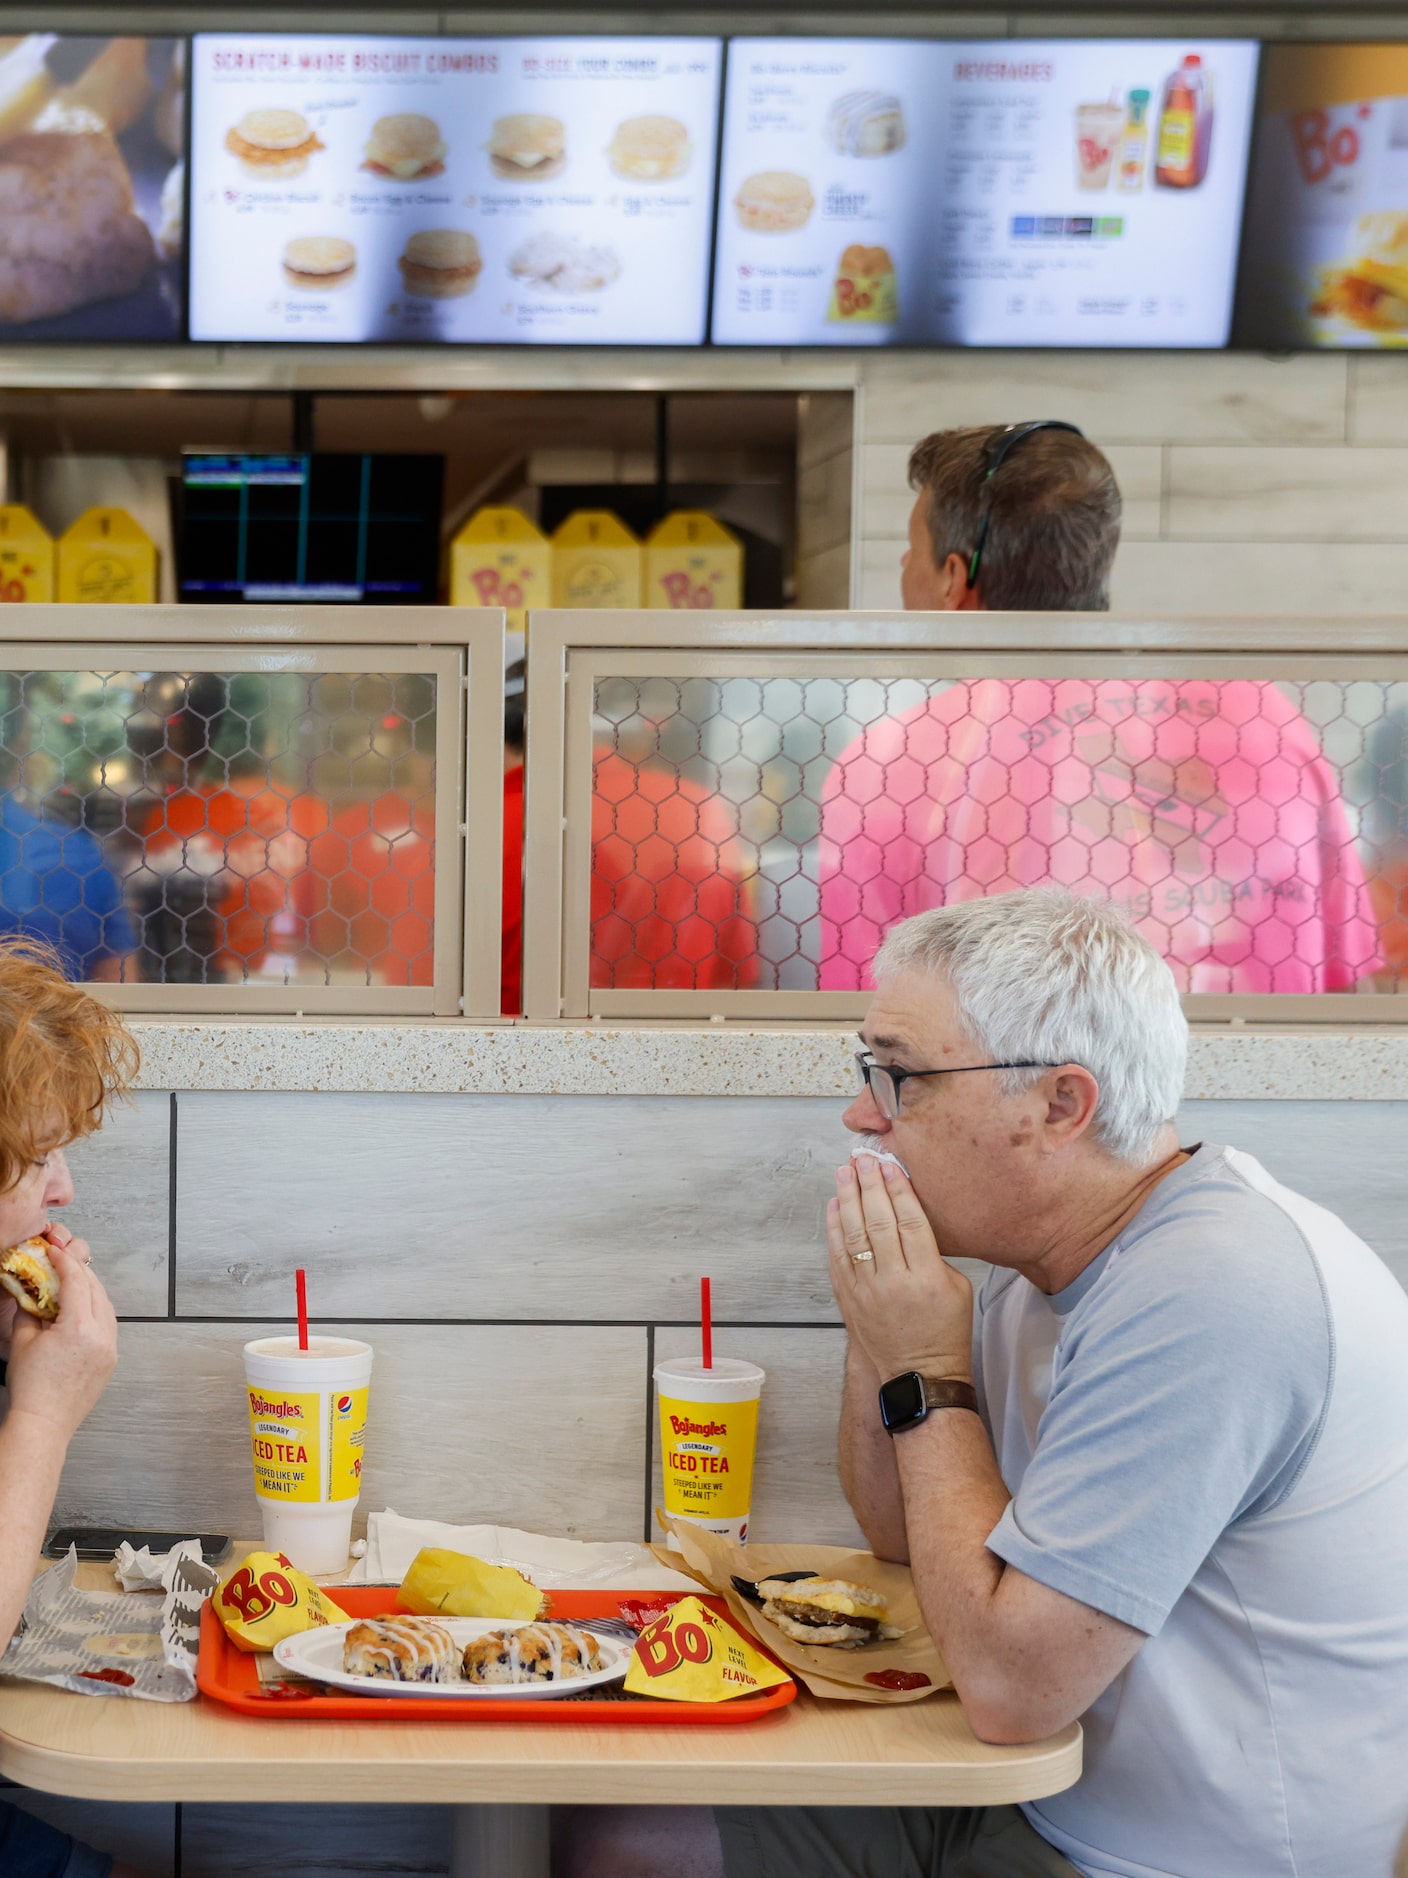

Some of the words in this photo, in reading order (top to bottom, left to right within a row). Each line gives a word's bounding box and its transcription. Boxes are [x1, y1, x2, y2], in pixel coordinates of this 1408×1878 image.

[353, 53, 422, 74] BISCUIT
[426, 53, 499, 74] COMBOS
[954, 61, 1055, 82] BEVERAGES
[1104, 696, 1218, 719] TEXAS
[249, 1392, 303, 1418] Bojangles
[258, 1423, 290, 1436] LEGENDARY
[669, 1415, 727, 1437] Bojangles
[252, 1437, 274, 1460] ICED
[275, 1443, 308, 1463] TEA
[681, 1442, 714, 1452] LEGENDARY
[669, 1451, 697, 1472] ICED
[700, 1456, 730, 1473] TEA
[255, 1464, 275, 1479] STEEPED
[276, 1470, 291, 1481] LIKE
[292, 1472, 305, 1481] WE
[262, 1478, 282, 1492] MEAN
[673, 1478, 697, 1489] STEEPED
[697, 1482, 712, 1491] LIKE
[712, 1483, 724, 1491] WE
[683, 1489, 703, 1500] MEAN
[728, 1646, 745, 1660] NEXT
[728, 1654, 748, 1670] LEVEL
[722, 1667, 759, 1687] FLAVOR
